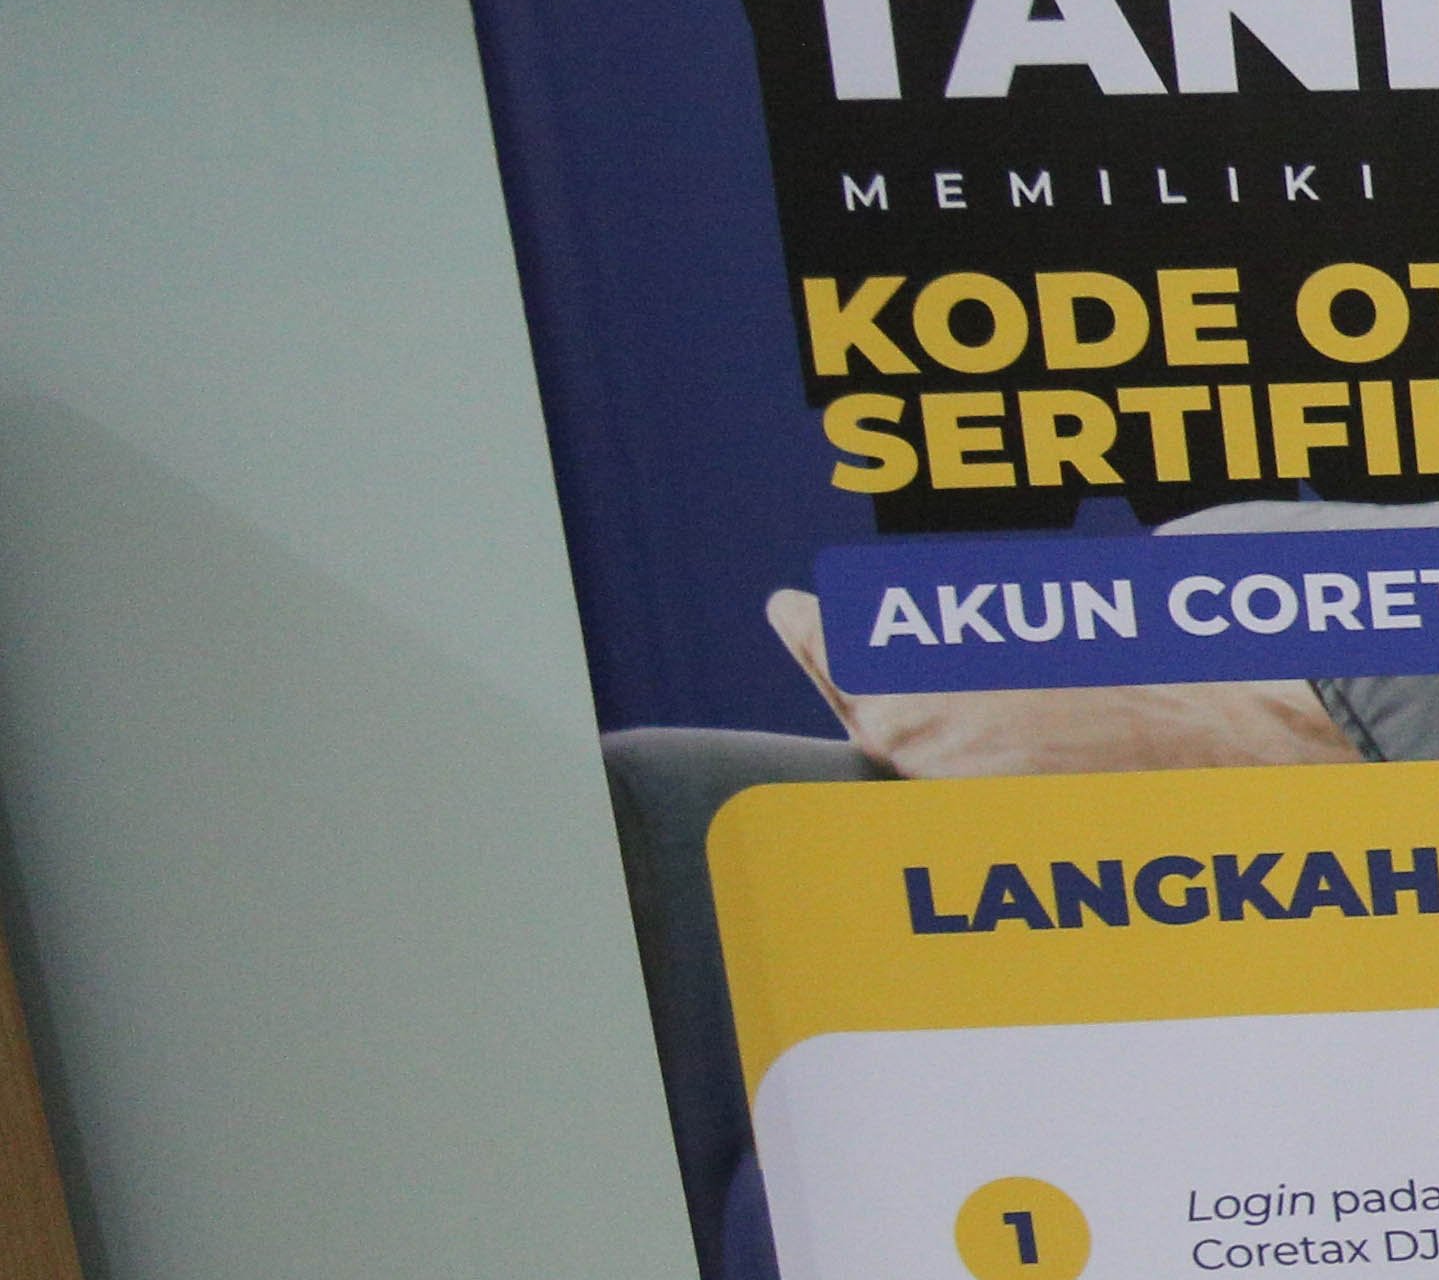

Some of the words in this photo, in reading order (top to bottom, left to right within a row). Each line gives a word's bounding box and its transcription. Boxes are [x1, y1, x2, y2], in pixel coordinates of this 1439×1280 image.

[843, 165, 1374, 211] MEMILIKI
[803, 268, 1249, 375] KODE
[869, 577, 1138, 646] AKUN
[1188, 1186, 1316, 1225] Login
[1001, 1210, 1040, 1265] 1
[1192, 1233, 1370, 1271] Coretax
